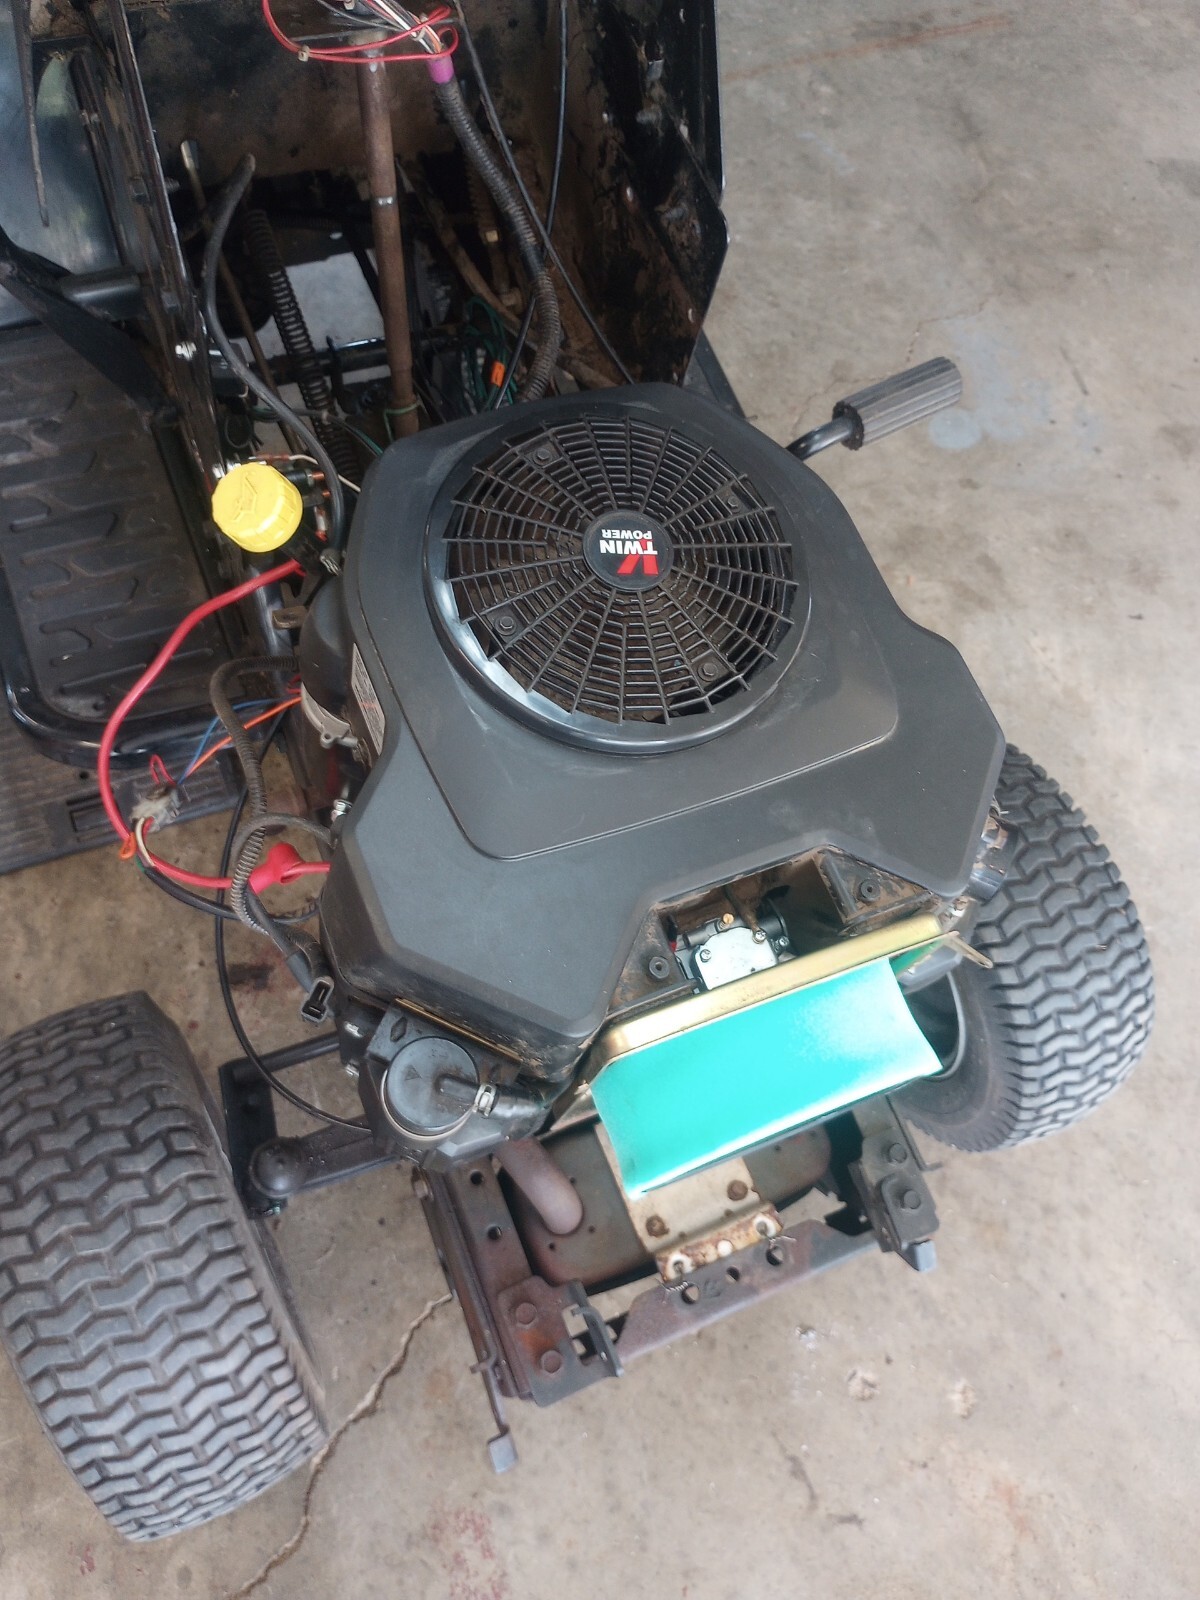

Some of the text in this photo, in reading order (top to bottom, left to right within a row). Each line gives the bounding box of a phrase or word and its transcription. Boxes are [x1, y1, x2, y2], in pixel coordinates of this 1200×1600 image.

[601, 529, 653, 540] POWER
[600, 540, 658, 555] TWIN
[617, 539, 659, 576] V
